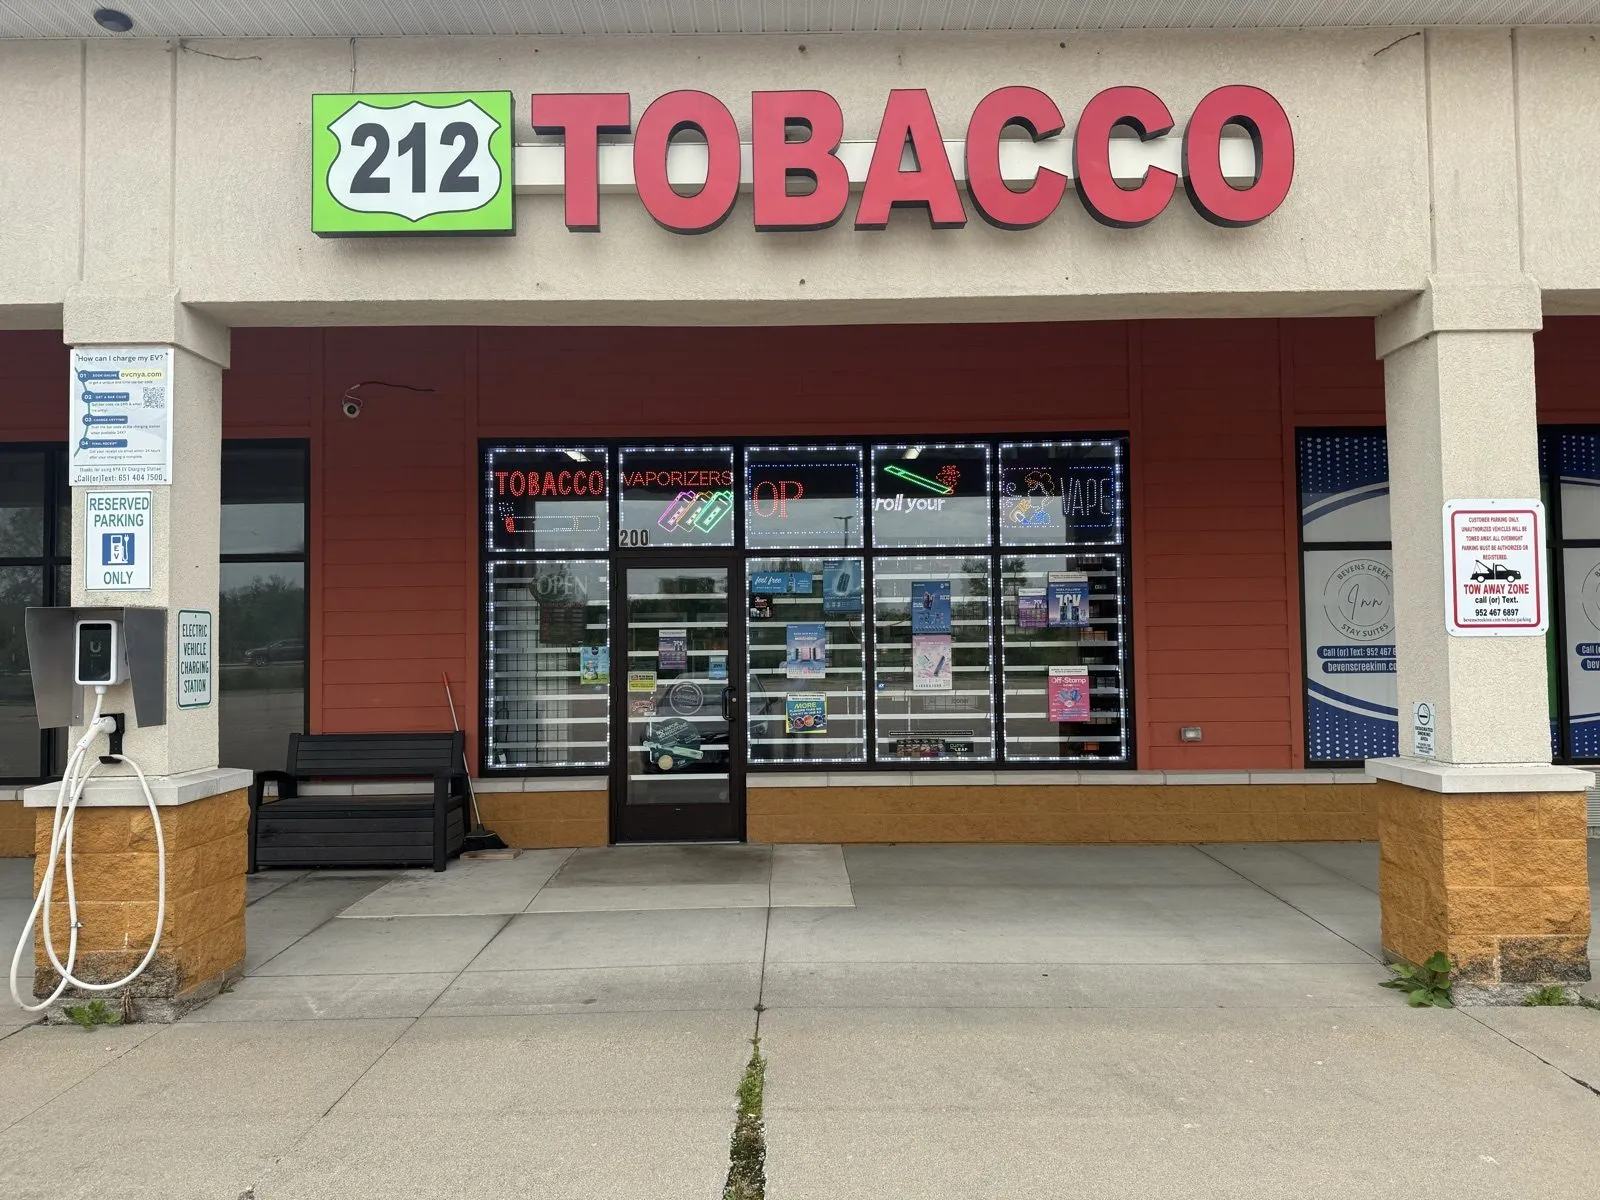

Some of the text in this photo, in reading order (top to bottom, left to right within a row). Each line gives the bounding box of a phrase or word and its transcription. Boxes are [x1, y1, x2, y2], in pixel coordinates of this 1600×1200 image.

[349, 85, 1295, 233] 212 TOBACCO
[113, 355, 136, 363] charge
[77, 475, 117, 483] Call(or)Text:
[495, 470, 604, 497] TOBACCO
[620, 470, 733, 487] VAPORIZERS
[89, 497, 150, 511] RESERVED
[874, 493, 945, 513] roll your
[1060, 477, 1112, 517] VAPE
[94, 513, 144, 527] PARKING
[619, 529, 649, 547] 200
[103, 571, 134, 585] ONLY
[1337, 563, 1391, 580] BEVENS CREEK
[536, 575, 588, 595] OPEN
[754, 576, 782, 586] feel free
[1463, 583, 1530, 595] TOW AWAY ZONE
[1347, 583, 1383, 620] Inn
[1474, 596, 1519, 605] call (or) Text.
[1475, 608, 1519, 617] 952 467 6897
[182, 623, 208, 638] ELECTRIC
[1341, 623, 1389, 637] STAY SUITES
[183, 642, 207, 656] VEHICLE
[1323, 648, 1336, 657] Call
[1336, 648, 1349, 657] (or)
[1350, 648, 1366, 656] Text:
[1366, 647, 1379, 656] 952
[1379, 647, 1392, 656] 467
[1581, 645, 1595, 654] Call
[180, 660, 209, 675] CHARGING
[1327, 661, 1397, 672] bevenscreekinn.co
[1586, 660, 1600, 669] bev
[183, 679, 206, 694] STATION
